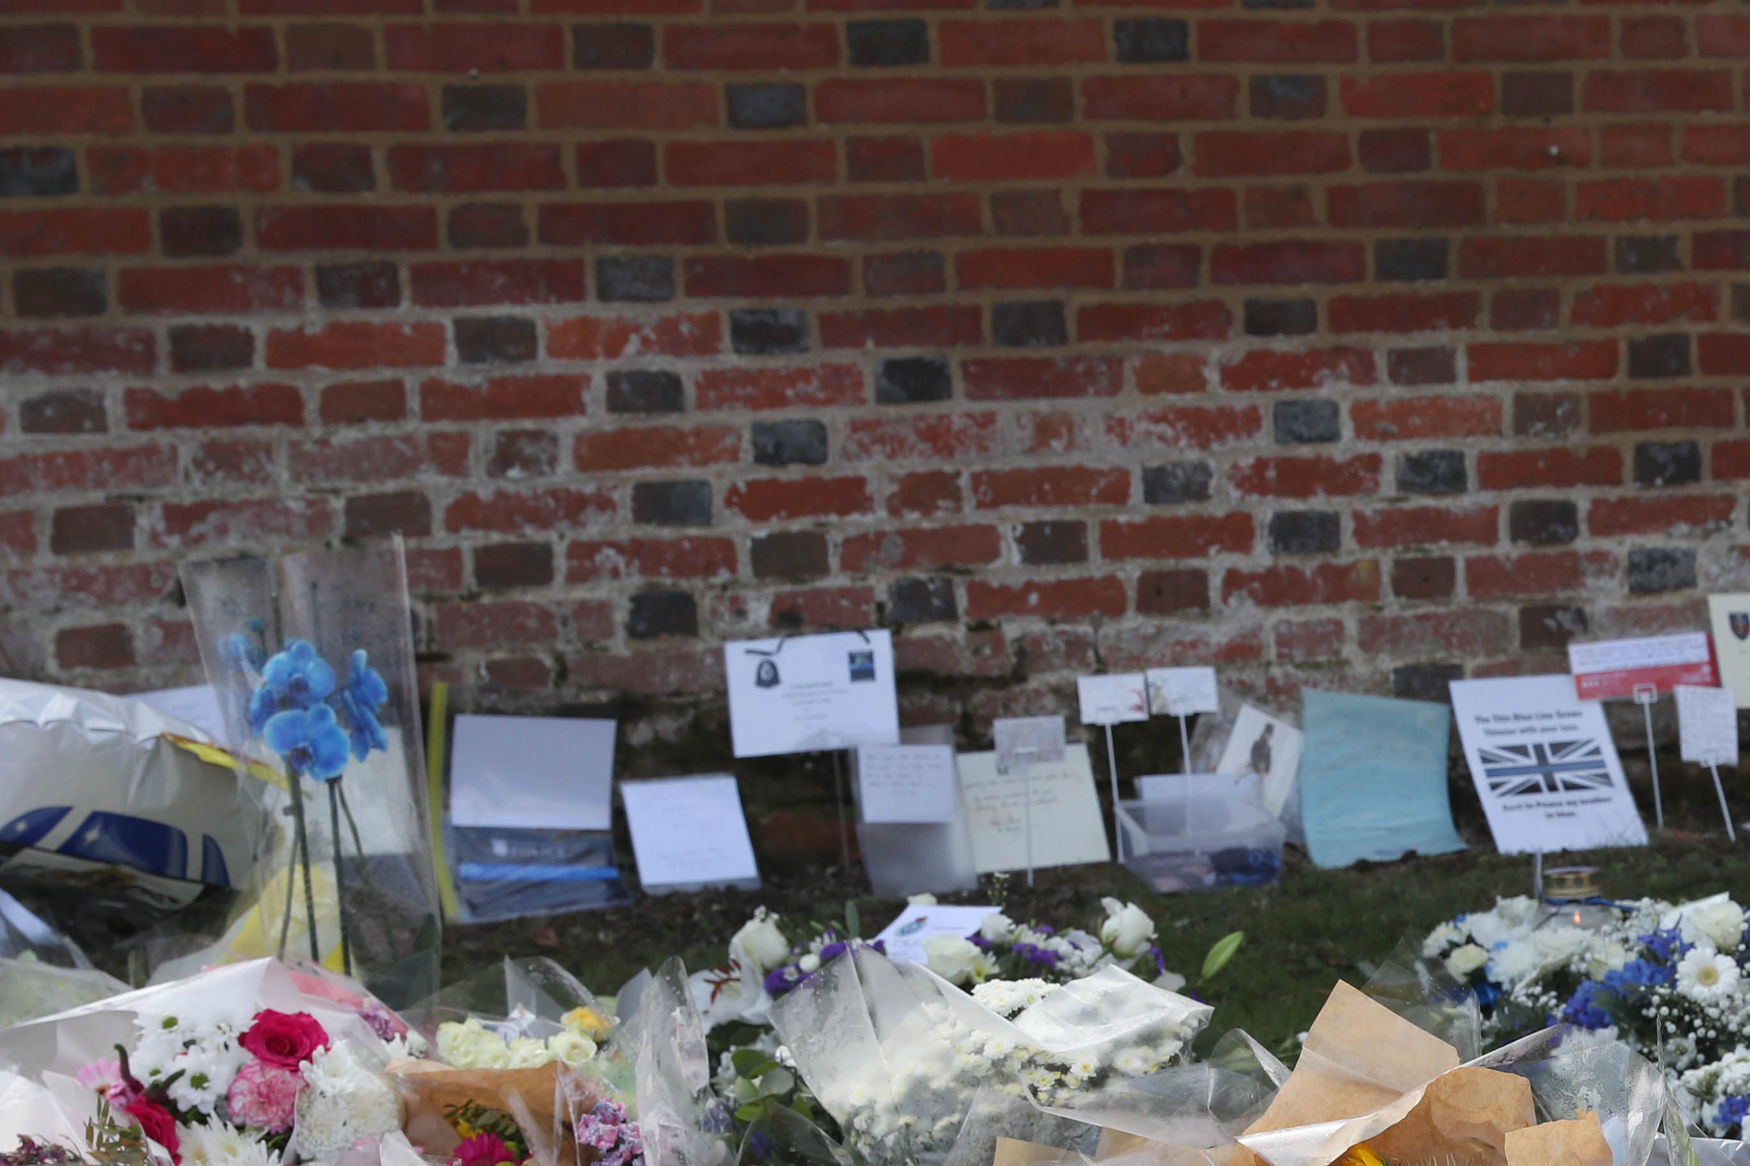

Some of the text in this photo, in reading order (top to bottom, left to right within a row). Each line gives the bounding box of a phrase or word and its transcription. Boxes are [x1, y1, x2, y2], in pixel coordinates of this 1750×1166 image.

[1492, 713, 1510, 723] Thin
[1513, 711, 1533, 721] Blue
[1535, 711, 1553, 720] Line
[1519, 726, 1538, 734] with
[1540, 725, 1559, 735] your
[1503, 802, 1523, 812] Rest
[1536, 800, 1562, 809] Peace
[1566, 800, 1579, 808] my
